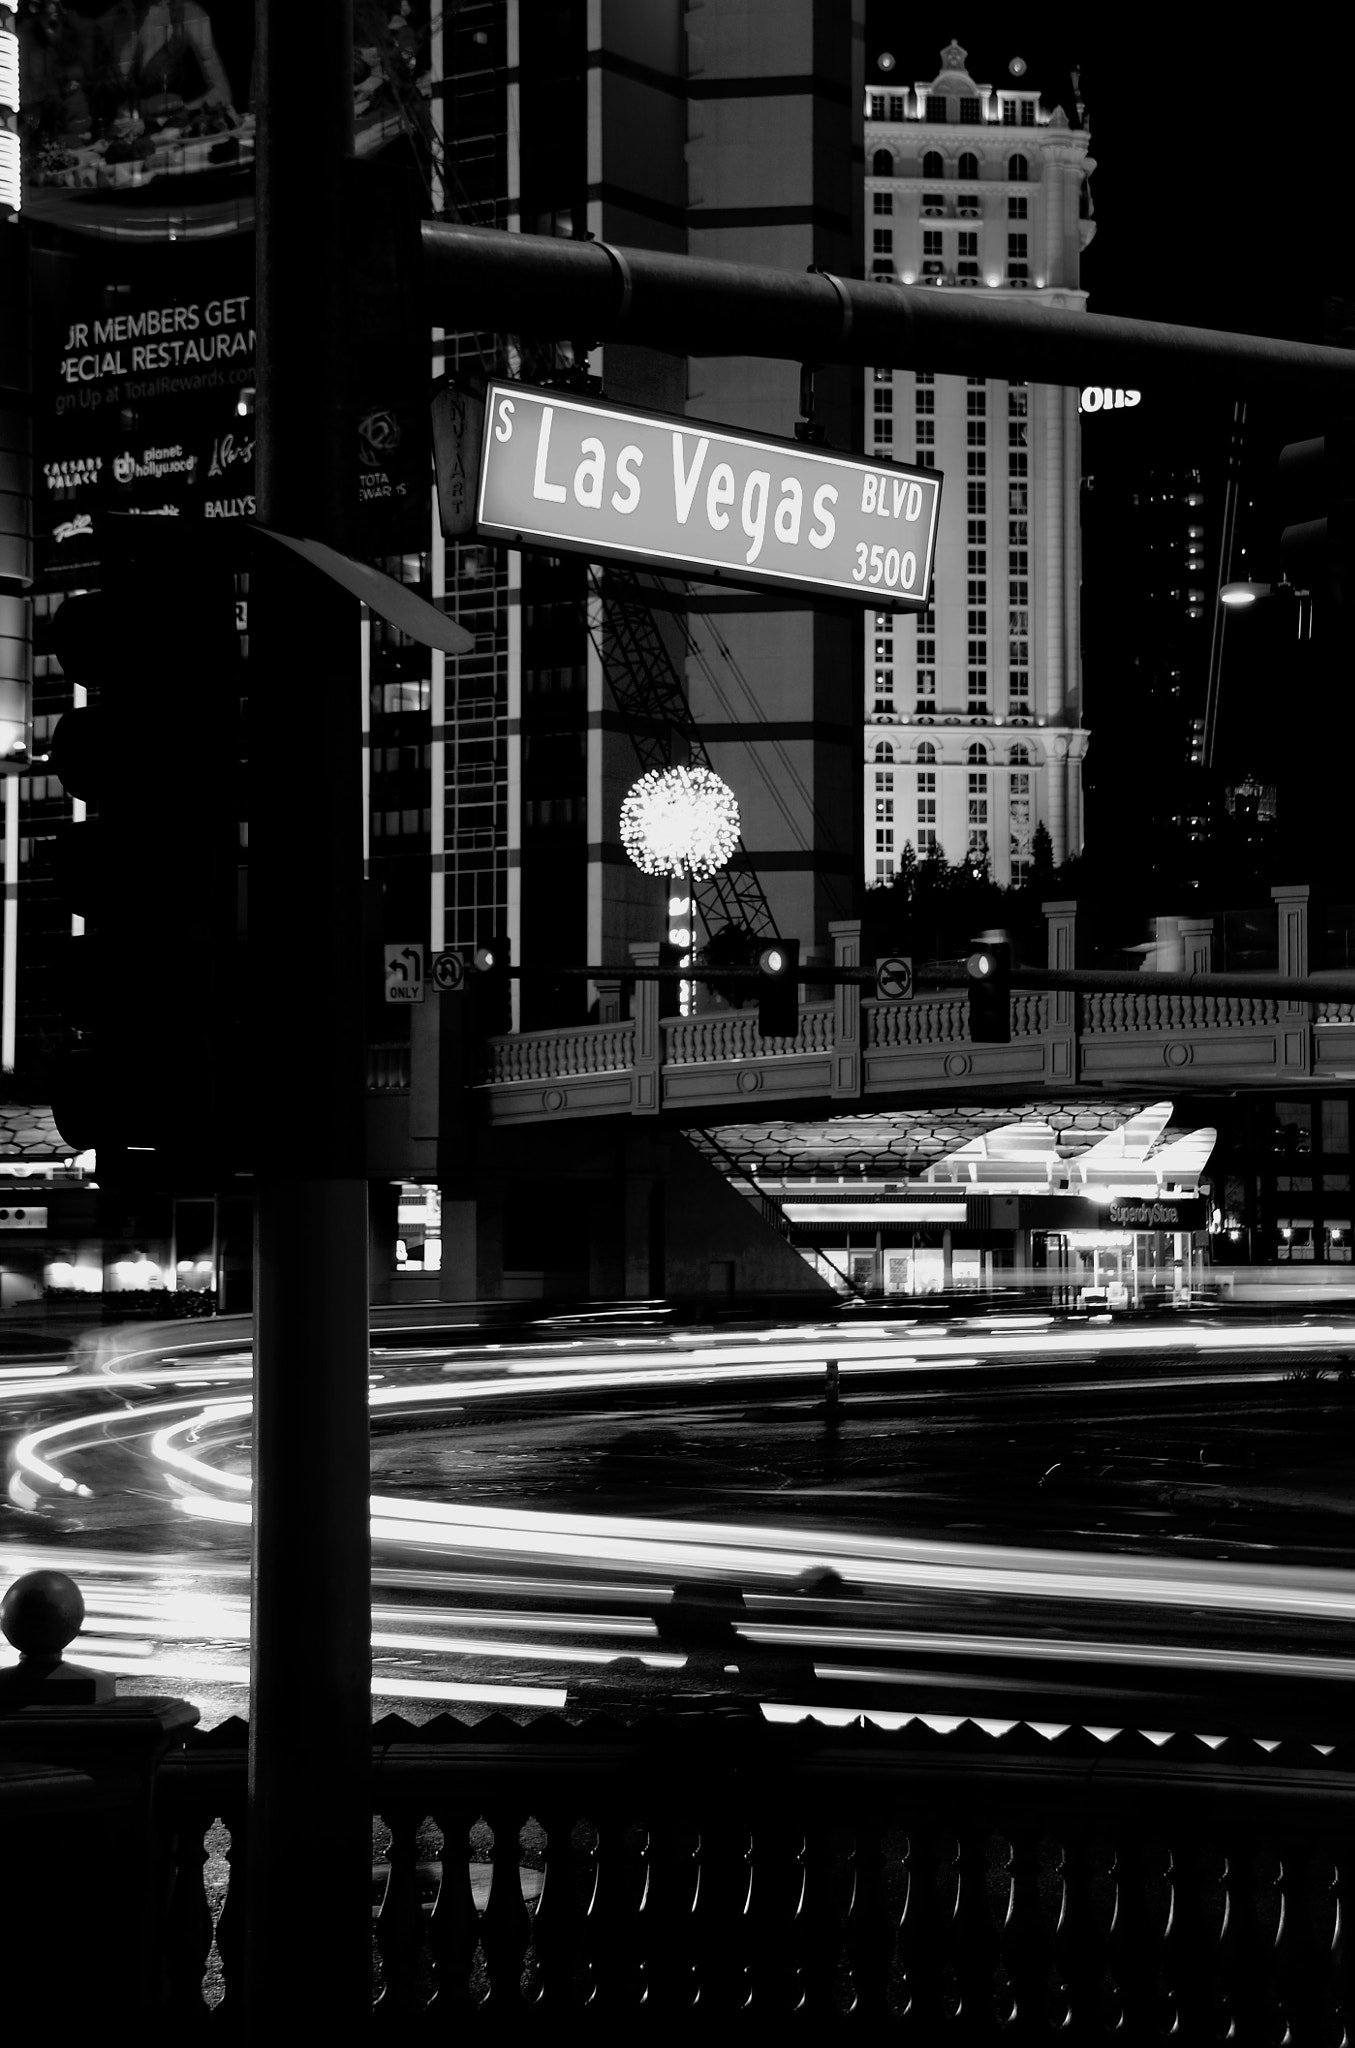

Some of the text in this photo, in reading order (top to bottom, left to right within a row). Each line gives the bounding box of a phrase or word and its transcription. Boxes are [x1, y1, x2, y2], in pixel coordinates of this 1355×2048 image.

[93, 304, 200, 344] MEMBERS
[204, 296, 250, 327] GET
[78, 387, 102, 411] Up
[105, 384, 120, 404] at
[143, 443, 183, 464] planet
[43, 456, 103, 477] CAESARS
[134, 454, 194, 478] hollywood
[46, 469, 98, 489] PALACE
[495, 399, 923, 565] S Las Vegas BLVD
[852, 542, 917, 590] 3500
[390, 986, 419, 999] ONLY
